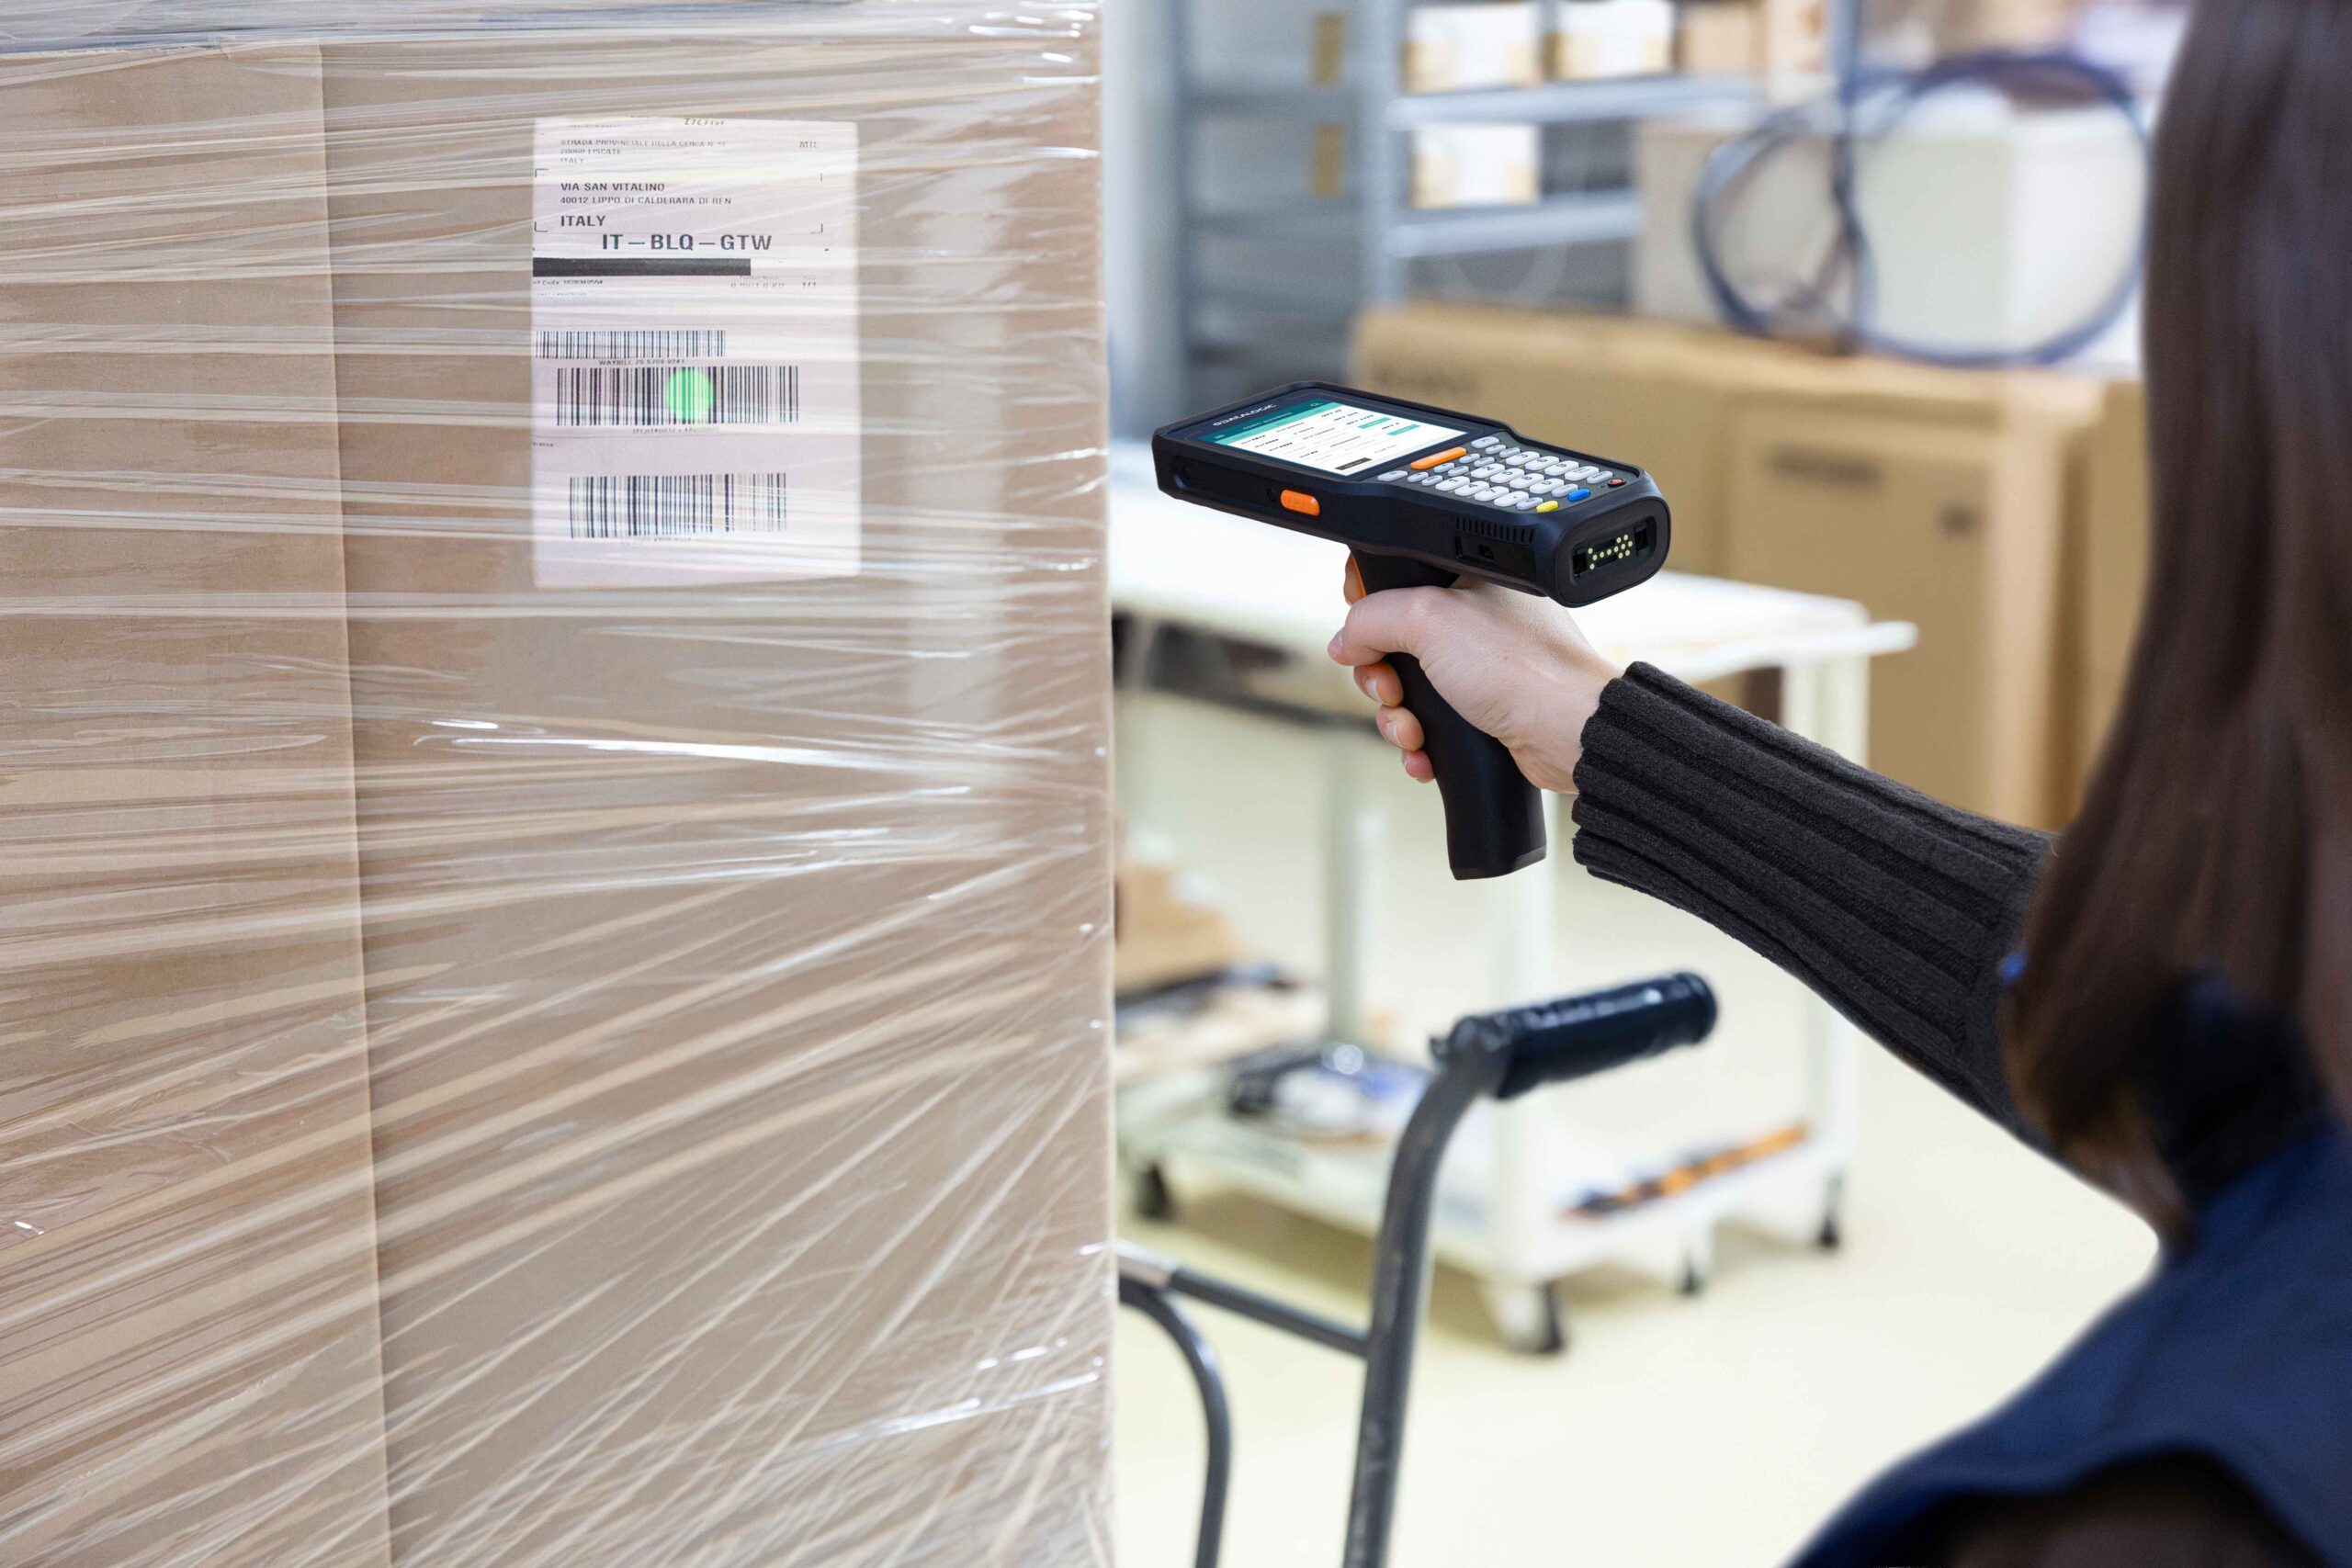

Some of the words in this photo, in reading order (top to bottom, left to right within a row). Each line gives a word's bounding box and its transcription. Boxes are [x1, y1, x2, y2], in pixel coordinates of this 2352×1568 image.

[560, 183, 580, 191] VIA
[584, 183, 607, 191] SAN
[613, 183, 665, 191] VITALINO
[560, 215, 605, 227] ITALY
